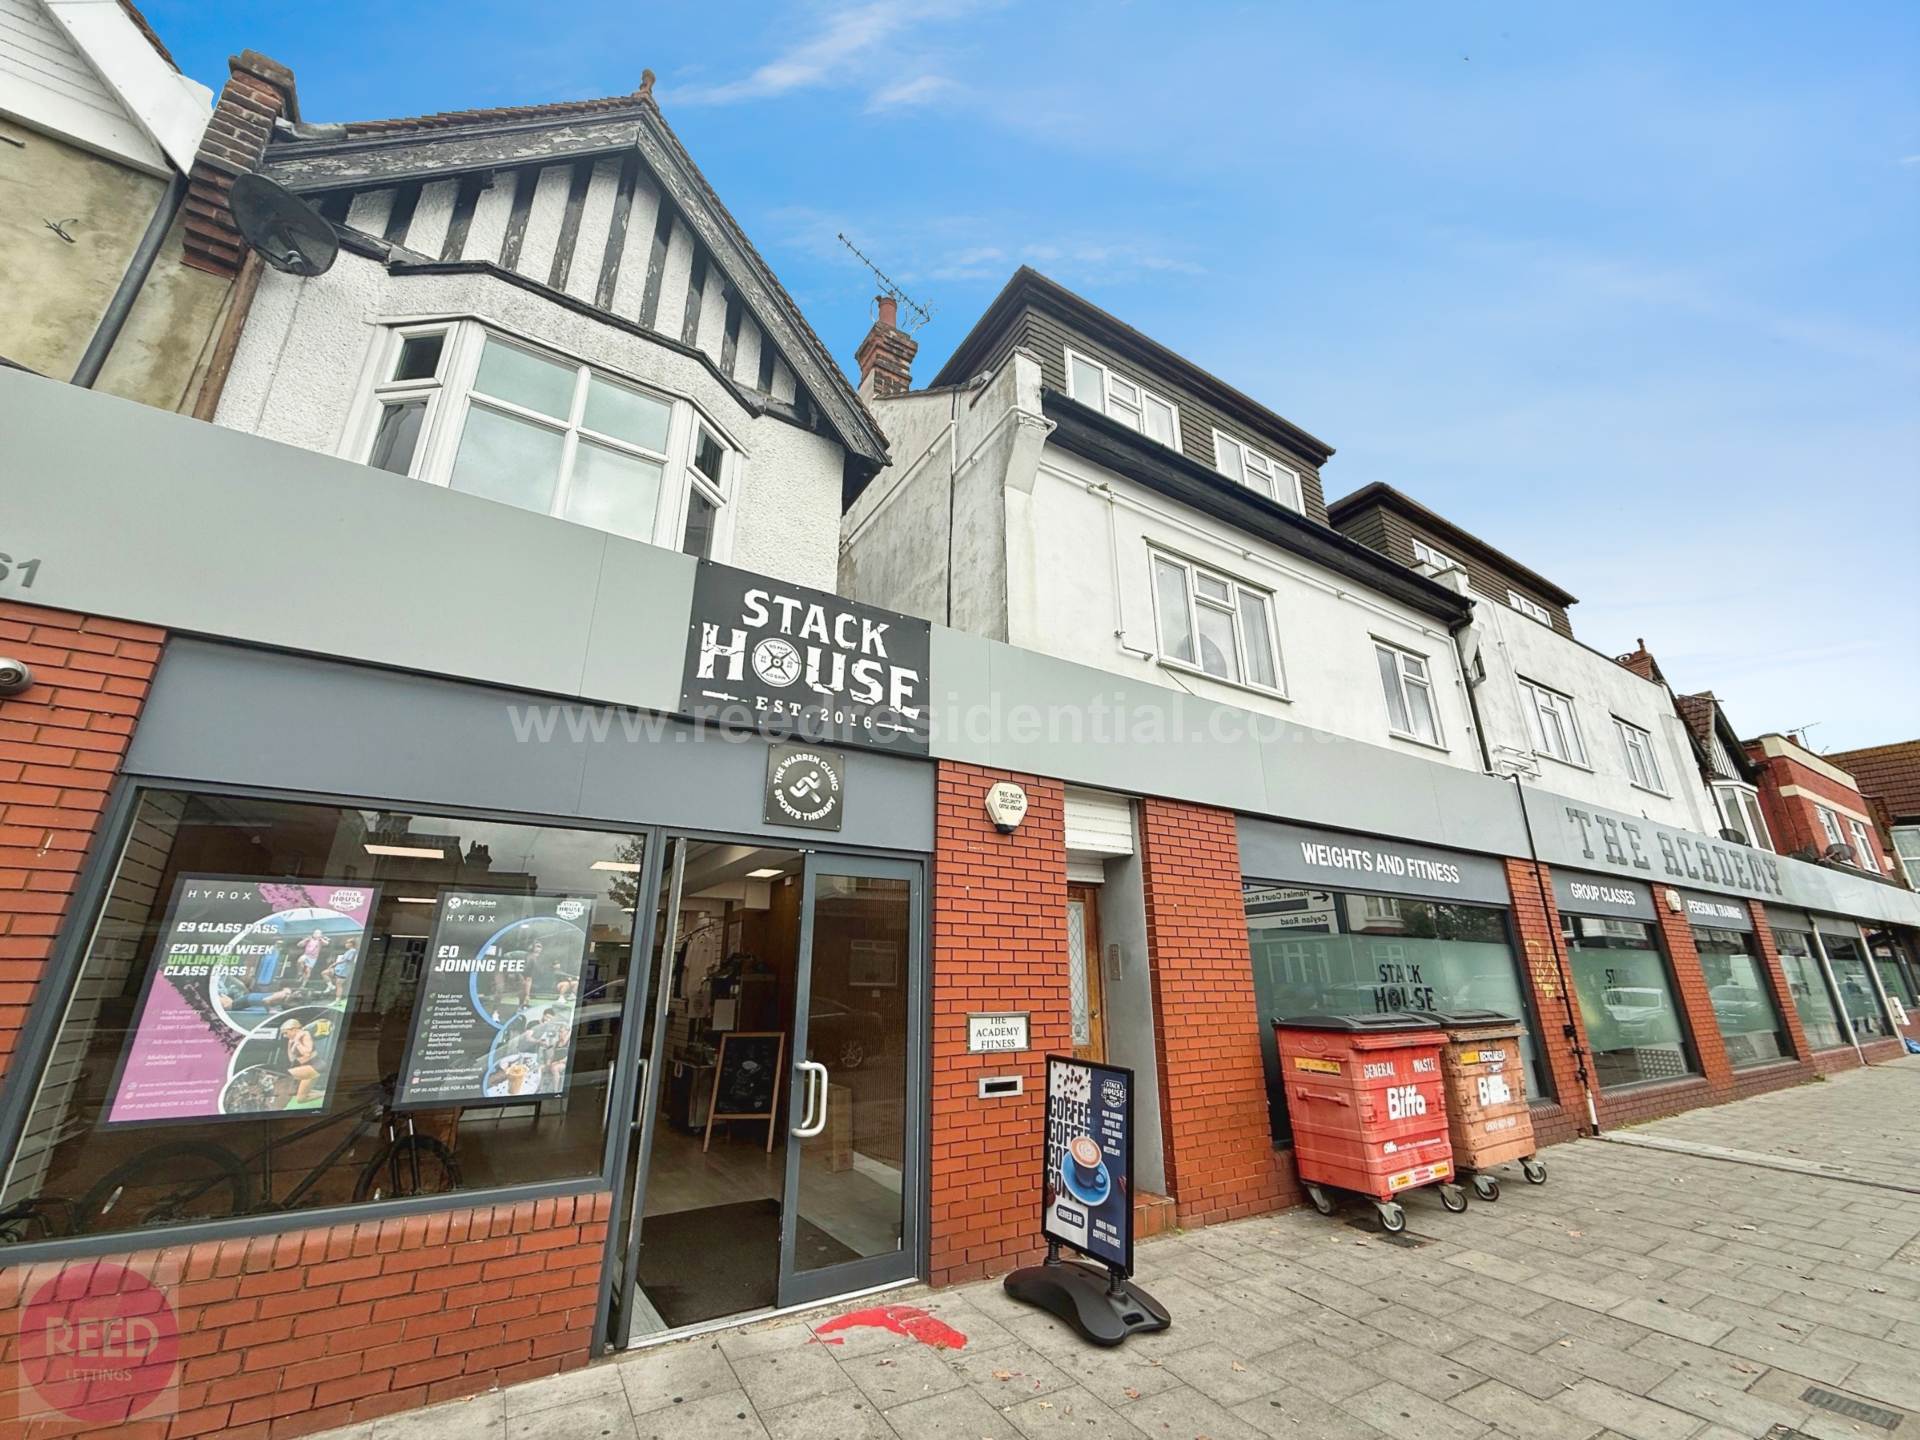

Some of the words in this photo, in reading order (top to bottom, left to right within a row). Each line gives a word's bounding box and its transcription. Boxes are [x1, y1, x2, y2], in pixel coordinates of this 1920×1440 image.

[741, 588, 890, 658] STACK
[696, 622, 920, 720] HOUSE
[755, 696, 811, 718] EST.
[820, 708, 872, 729] 2016
[774, 766, 786, 784] THE
[781, 753, 820, 768] WARREN
[820, 761, 839, 791] CLINIC
[774, 789, 801, 819] SPORTS
[803, 796, 836, 821] THERAPY
[1566, 807, 1651, 870] THE
[1657, 831, 1784, 896] ACADEMY
[1300, 842, 1373, 872] WEIGHTS
[1376, 852, 1405, 877] AND
[1406, 858, 1460, 884] FITNESS
[187, 889, 252, 900] HYROX
[1570, 882, 1600, 901] GROUP
[1601, 885, 1636, 905] CLASSES
[1687, 900, 1718, 917] PERSONAL
[1719, 903, 1743, 920] TRAINING
[176, 922, 196, 933] £9
[199, 922, 241, 933] CLASS
[245, 923, 278, 934] PASS
[170, 944, 198, 954] £20
[201, 944, 233, 955] TWO
[235, 944, 274, 955] WEEK
[438, 945, 459, 958] £0
[167, 955, 241, 965] UNLIMITED
[435, 959, 496, 972] JOINING
[498, 959, 525, 972] FEE
[163, 966, 208, 976] CLASS
[211, 966, 247, 976] PASS
[990, 1016, 1007, 1024] THE
[976, 1027, 1019, 1037] ACADEMY
[981, 1039, 1016, 1048] FITNESS
[1363, 1062, 1395, 1079] GENERAL
[1412, 1058, 1436, 1072] WASTE
[1106, 1081, 1120, 1089] STACK
[1103, 1087, 1124, 1098] HOUSE
[1387, 1085, 1427, 1121] Biffa
[1049, 1095, 1090, 1127] COFFEE
[1058, 1208, 1072, 1221] SERVED
